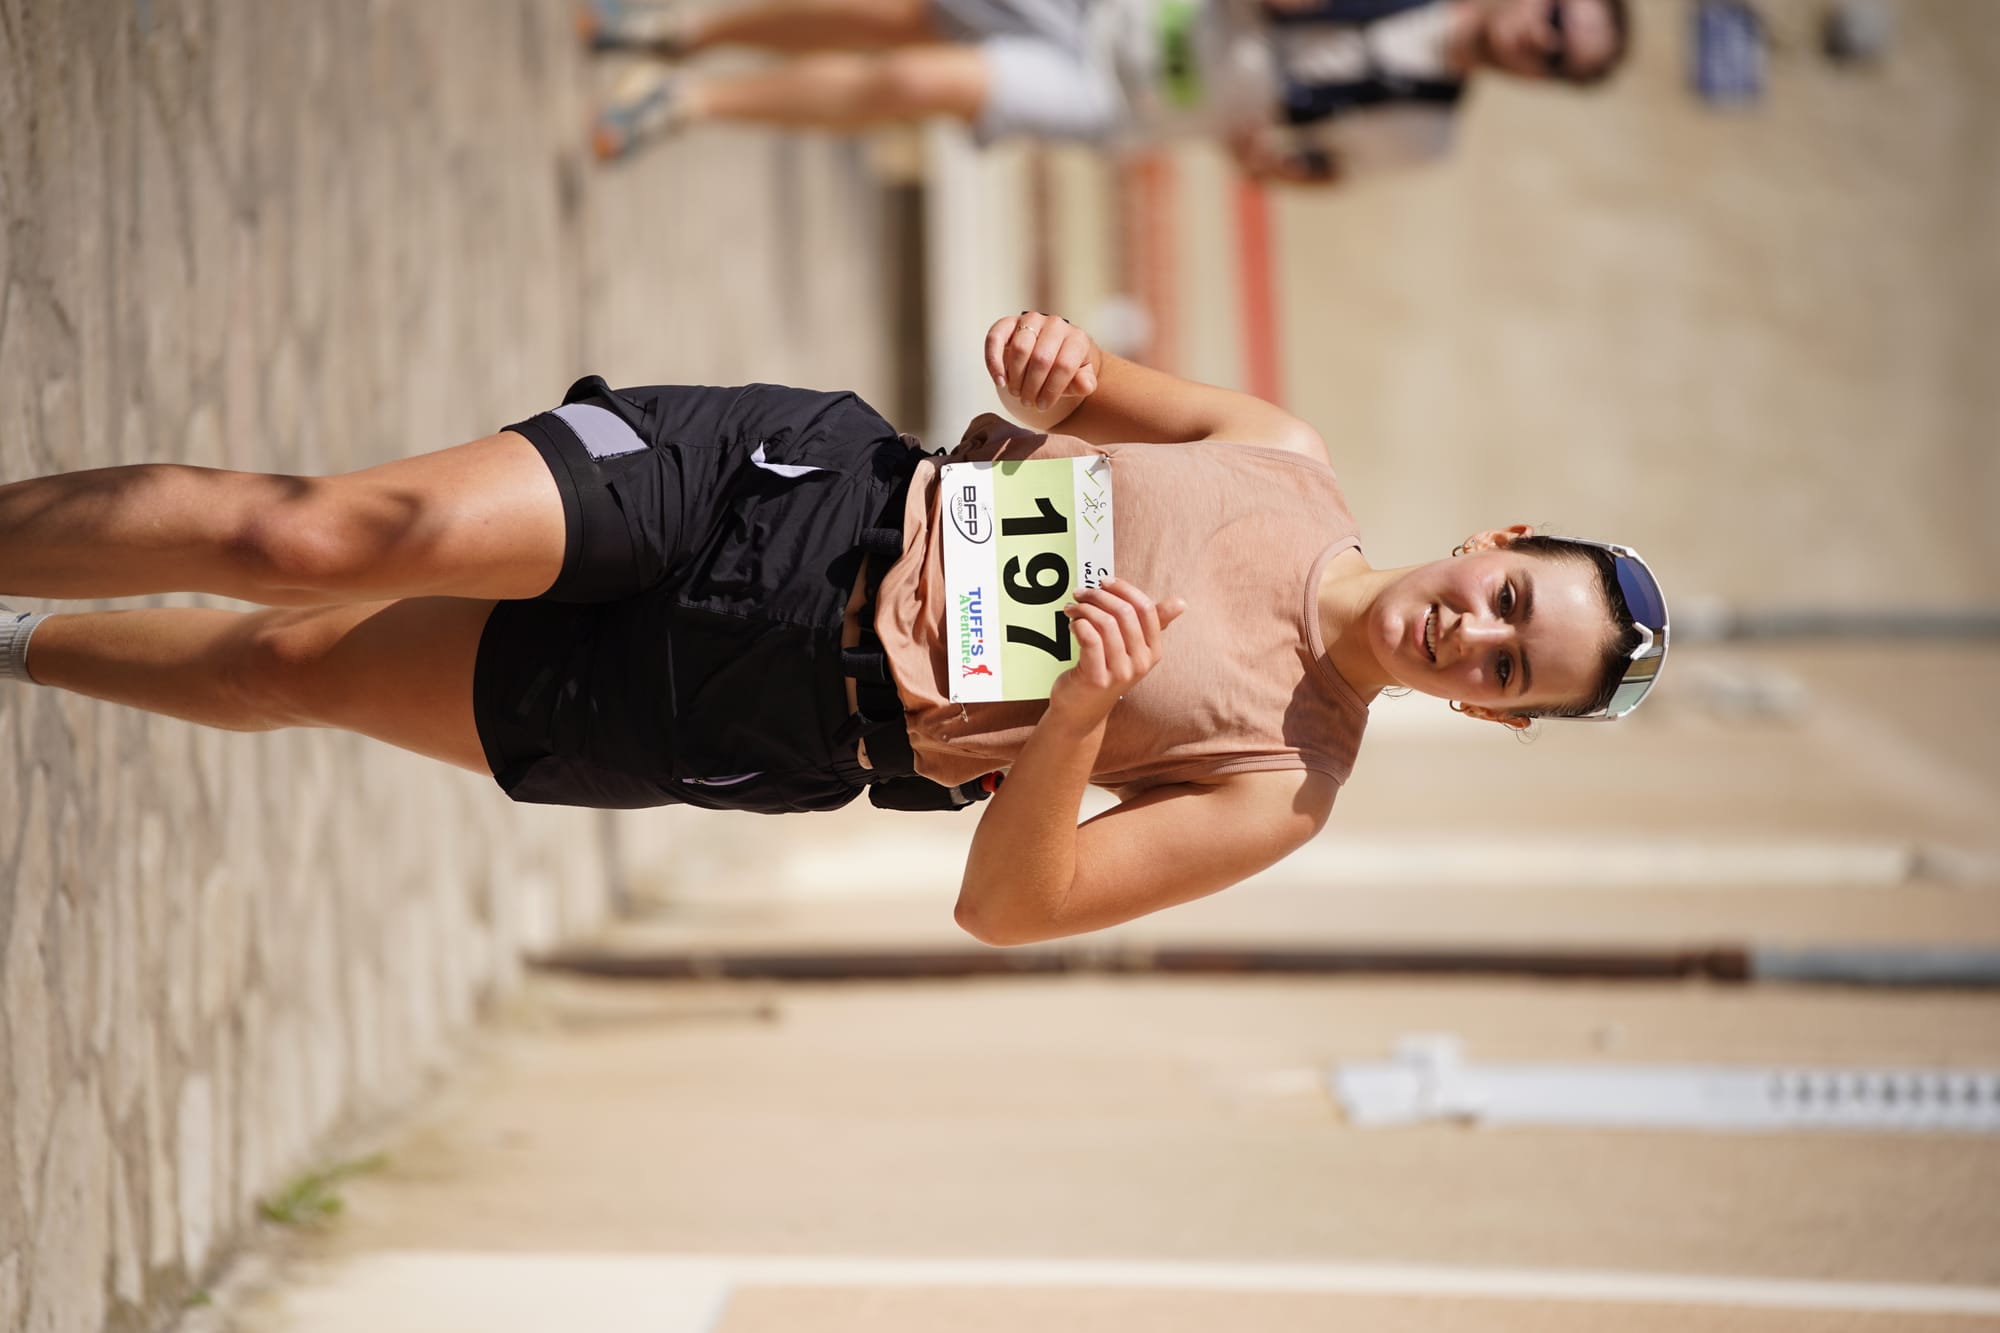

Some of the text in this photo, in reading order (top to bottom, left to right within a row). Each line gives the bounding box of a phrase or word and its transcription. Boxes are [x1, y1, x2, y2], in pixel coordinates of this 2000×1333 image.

[963, 485, 978, 536] BFP
[1002, 497, 1072, 662] 197
[1084, 561, 1095, 589] vall
[959, 594, 972, 664] Aventure
[968, 587, 984, 656] TUFF'S
